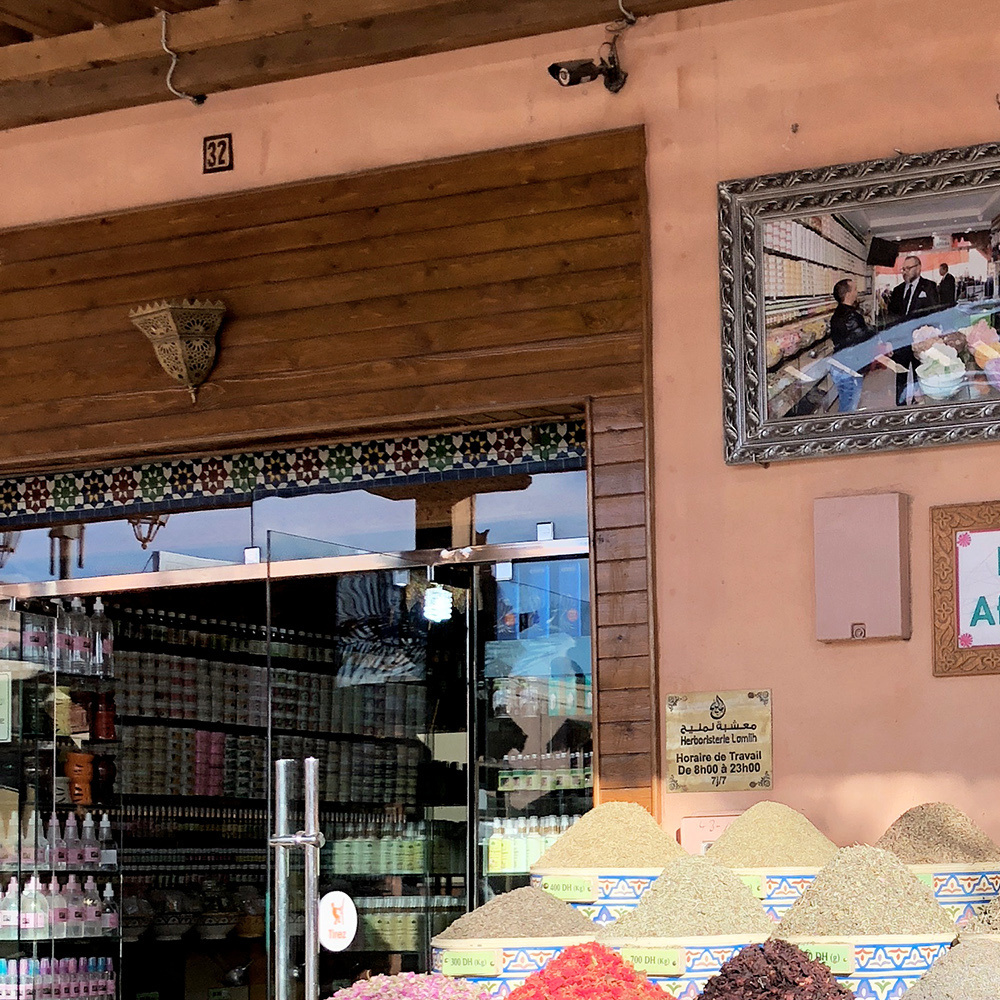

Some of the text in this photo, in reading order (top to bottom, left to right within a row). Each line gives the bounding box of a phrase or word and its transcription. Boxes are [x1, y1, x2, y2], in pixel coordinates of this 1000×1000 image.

[207, 140, 227, 167] 32
[716, 720, 757, 733] معشبة
[680, 734, 730, 745] Herboristerie
[676, 750, 762, 763] Horaire de Travail
[678, 762, 761, 775] De 8h00 à 23h00
[562, 883, 572, 891] DH
[462, 957, 473, 966] DH
[644, 956, 656, 965] DH
